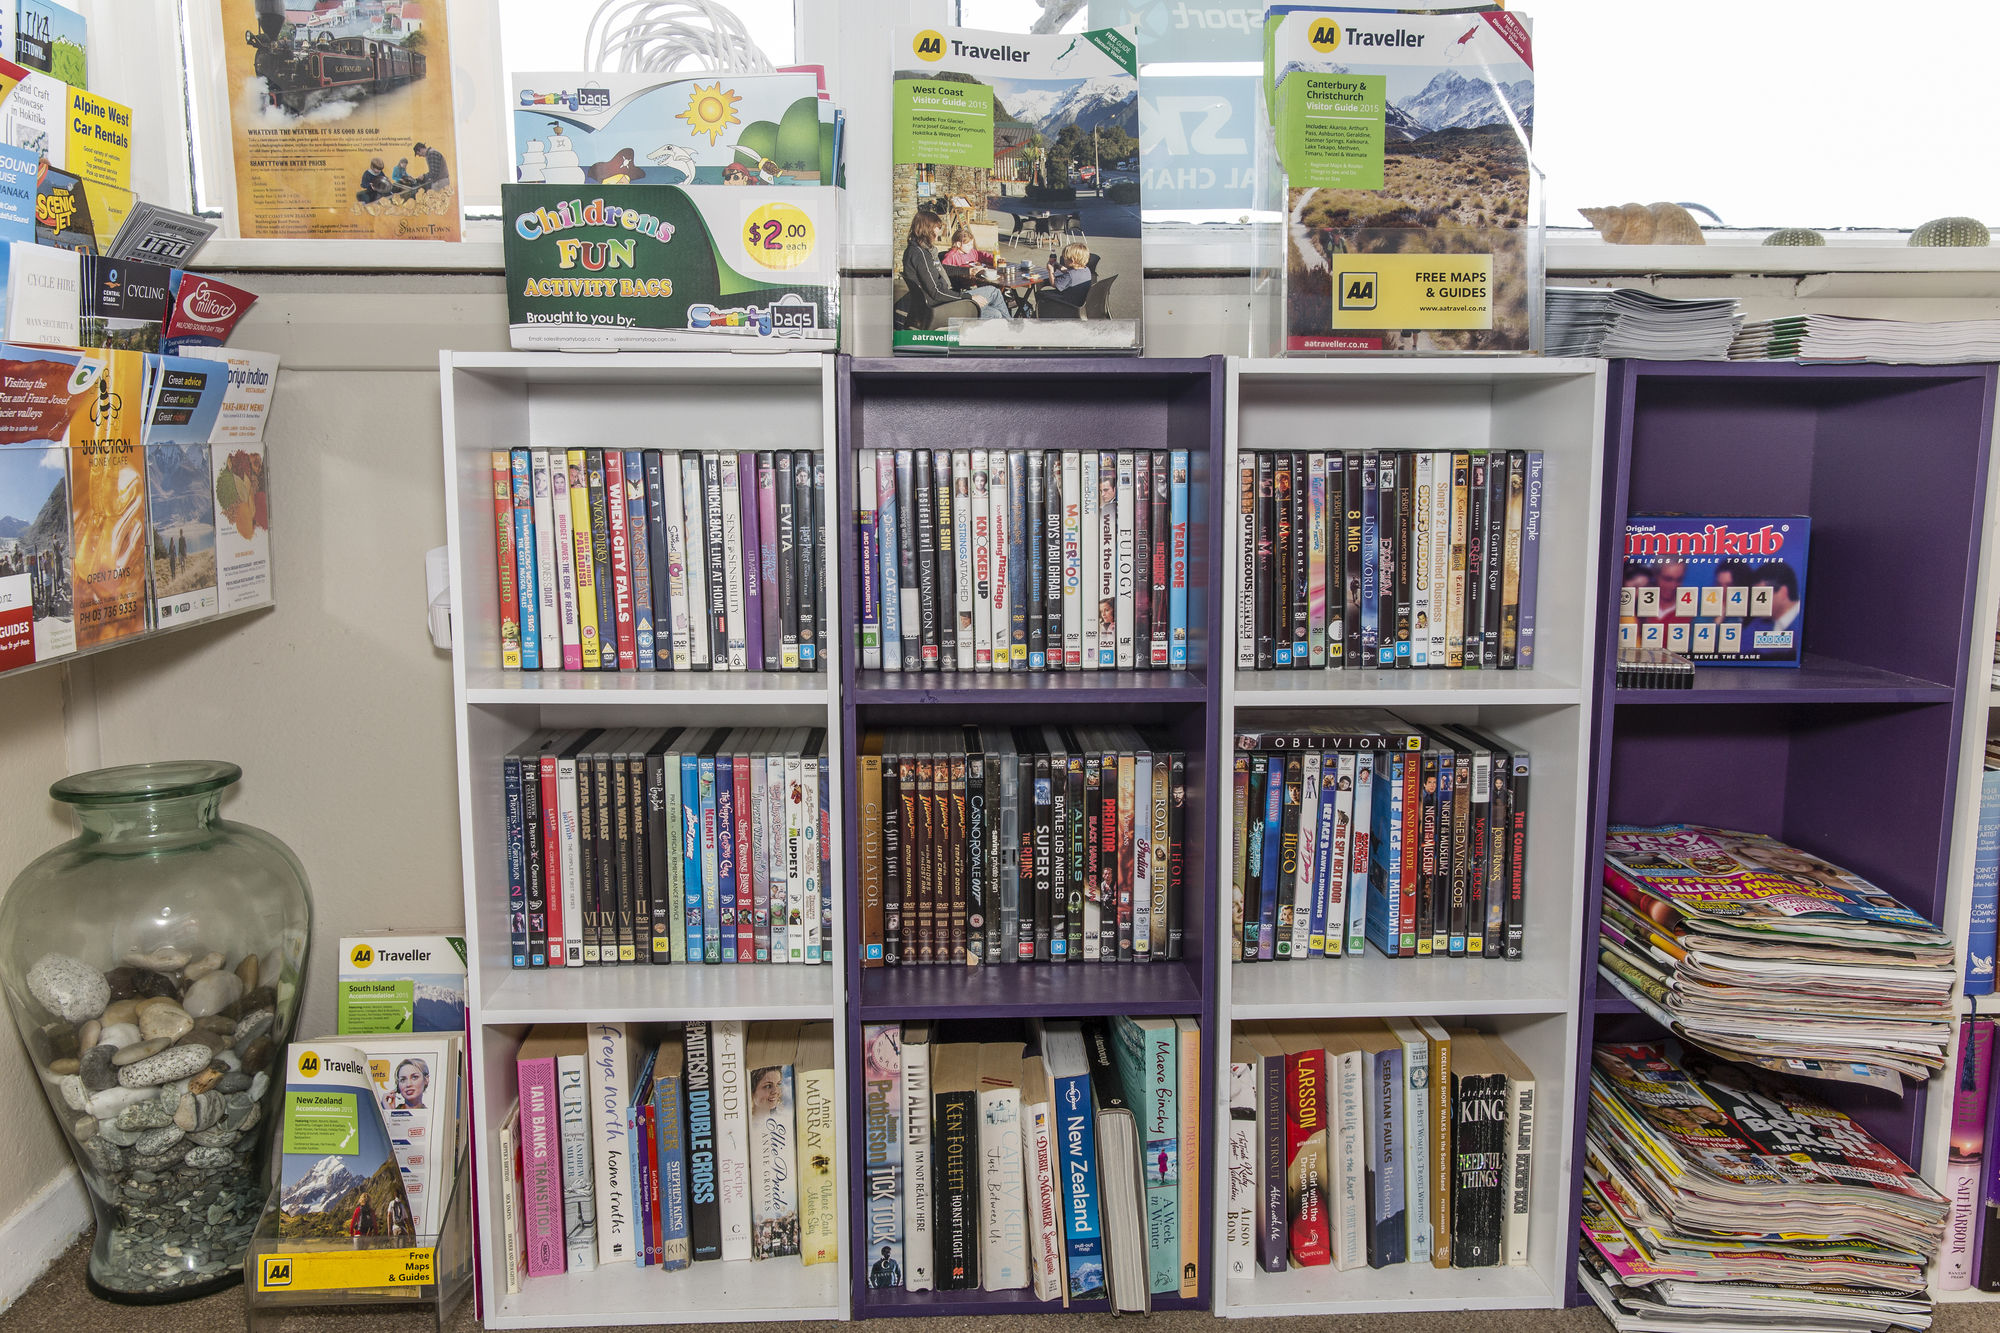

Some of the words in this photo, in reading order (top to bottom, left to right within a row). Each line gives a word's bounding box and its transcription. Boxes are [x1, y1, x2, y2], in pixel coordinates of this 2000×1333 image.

[1105, 31, 1118, 43] FREE
[1115, 40, 1132, 54] GUIDE
[1312, 27, 1335, 44] AA
[1345, 28, 1425, 47] Traveller
[918, 38, 941, 54] AA
[951, 40, 1030, 63] Traveller
[20, 84, 31, 94] and
[33, 86, 50, 101] Craft
[912, 86, 935, 96] West
[938, 87, 964, 97] Coast
[1307, 79, 1357, 91] Canterbury
[1359, 82, 1367, 91] &
[1307, 91, 1364, 101] Christchurch
[13, 92, 43, 111] Showcase
[74, 94, 105, 118] Alpine
[108, 105, 129, 127] West
[912, 96, 940, 105] Visitor
[942, 97, 966, 107] Guide
[968, 98, 988, 109] 2015
[1306, 101, 1333, 111] Visitor
[1334, 103, 1358, 113] Guide
[1360, 104, 1379, 113] 2015
[11, 106, 17, 115] in
[20, 108, 45, 125] Hokitika
[73, 118, 91, 136] Car
[94, 122, 129, 149] Rentals
[0, 156, 37, 175] SOUND
[37, 193, 77, 220] SCENIC
[53, 211, 71, 235] JET
[515, 199, 675, 242] Childrens
[748, 219, 807, 250] $2.00
[557, 239, 636, 271] FUN
[786, 242, 807, 252] each
[524, 278, 617, 298] ACTIVITY
[620, 278, 673, 298] BAGS
[1415, 272, 1447, 283] FREE
[1450, 272, 1487, 283] MAPS
[127, 284, 164, 300] CYCLING
[195, 282, 210, 300] Go
[1346, 281, 1374, 299] AA
[1426, 288, 1436, 298] &
[1439, 287, 1487, 298] GUIDES
[196, 298, 236, 316] milford
[1419, 305, 1487, 313] www.aatravel.co.nz
[176, 322, 193, 330] MILFORD
[193, 323, 208, 331] SOUND
[527, 311, 573, 325] Brought
[576, 312, 587, 323] to
[590, 314, 614, 325] you
[616, 314, 636, 327] by:
[1304, 340, 1369, 349] aatraveller.co.nz
[4, 377, 33, 389] Visiting
[35, 378, 47, 389] the
[168, 375, 184, 385] Great
[184, 377, 202, 387] advice
[246, 368, 269, 385] indian
[11, 394, 25, 403] and
[26, 393, 47, 404] Franz
[48, 394, 72, 405] Josef
[164, 393, 179, 403] Great
[179, 395, 195, 404] walks
[222, 402, 249, 411] TAKE-AWAY
[250, 403, 264, 412] MENU
[17, 407, 43, 420] valleys
[159, 412, 173, 421] Great
[81, 438, 133, 455] JUNCTION
[89, 457, 110, 467] HONEY
[113, 456, 128, 466] CAFE
[1531, 458, 1542, 478] The
[1529, 481, 1542, 508] Color
[609, 483, 623, 530] WHEN
[707, 484, 723, 545] NICKELBACK
[1347, 510, 1361, 520] 8
[780, 503, 793, 553] EVITA
[1103, 514, 1112, 546] walk
[1526, 510, 1540, 541] Purple
[1064, 503, 1080, 596] MOTHERHOOD
[1172, 522, 1186, 558] YEAR
[1348, 525, 1361, 552] Mile
[613, 536, 626, 573] CITY
[711, 547, 722, 569] LIVE
[1104, 548, 1112, 570] the
[1120, 529, 1132, 599] EULOGY
[1363, 515, 1375, 600] UNDERWORLD
[87, 572, 106, 585] OPEN
[107, 570, 111, 579] 7
[114, 567, 131, 579] DAYS
[712, 570, 722, 581] AT
[1104, 572, 1112, 595] line
[1172, 562, 1185, 588] ONE
[616, 577, 629, 623] FALLS
[713, 584, 724, 614] HOME
[80, 612, 90, 624] PH
[103, 606, 117, 618] 736
[119, 601, 137, 616] 9333
[0, 621, 29, 638] GUIDES
[1274, 737, 1387, 748] OBLIVION
[1054, 795, 1065, 832] BATTLE:
[1514, 811, 1525, 830] THE
[1101, 798, 1116, 853] PREDATOR
[1036, 825, 1050, 877] SUPER
[1055, 834, 1065, 854] LOS
[1282, 832, 1298, 875] HUGO
[865, 802, 878, 909] GLADIATOR
[1512, 832, 1524, 900] COMMITMENTS
[1055, 856, 1065, 900] ANGELES
[1656, 883, 1742, 893] KILLED
[354, 950, 371, 962] AA
[378, 949, 431, 962] Traveller
[349, 984, 370, 992] South
[372, 984, 395, 992] Island
[300, 1058, 318, 1071] AA
[323, 1058, 364, 1075] Traveller
[1156, 1041, 1171, 1085] Maeve
[721, 1053, 739, 1121] FFORDE
[1298, 1056, 1317, 1129] LARSSON
[1382, 1059, 1391, 1119] SEBASTIAN
[296, 1097, 313, 1105] New
[315, 1097, 343, 1105] Zealand
[531, 1085, 544, 1112] IAIN
[689, 1090, 712, 1150] DOUBLE
[1149, 1089, 1173, 1134] Binchy
[1461, 1099, 1505, 1124] KING
[531, 1116, 547, 1159] BANKS
[1067, 1115, 1085, 1157] New
[1383, 1120, 1393, 1164] FAULKS
[691, 1151, 715, 1205] CROSS
[871, 1166, 896, 1201] TICK
[1070, 1160, 1092, 1232] Zealand
[872, 1205, 896, 1245] TOCK
[1951, 1202, 1973, 1255] HARBOUR
[405, 1262, 430, 1272] Maps
[409, 1252, 430, 1260] Free
[269, 1264, 290, 1279] AA
[398, 1272, 430, 1283] Guides
